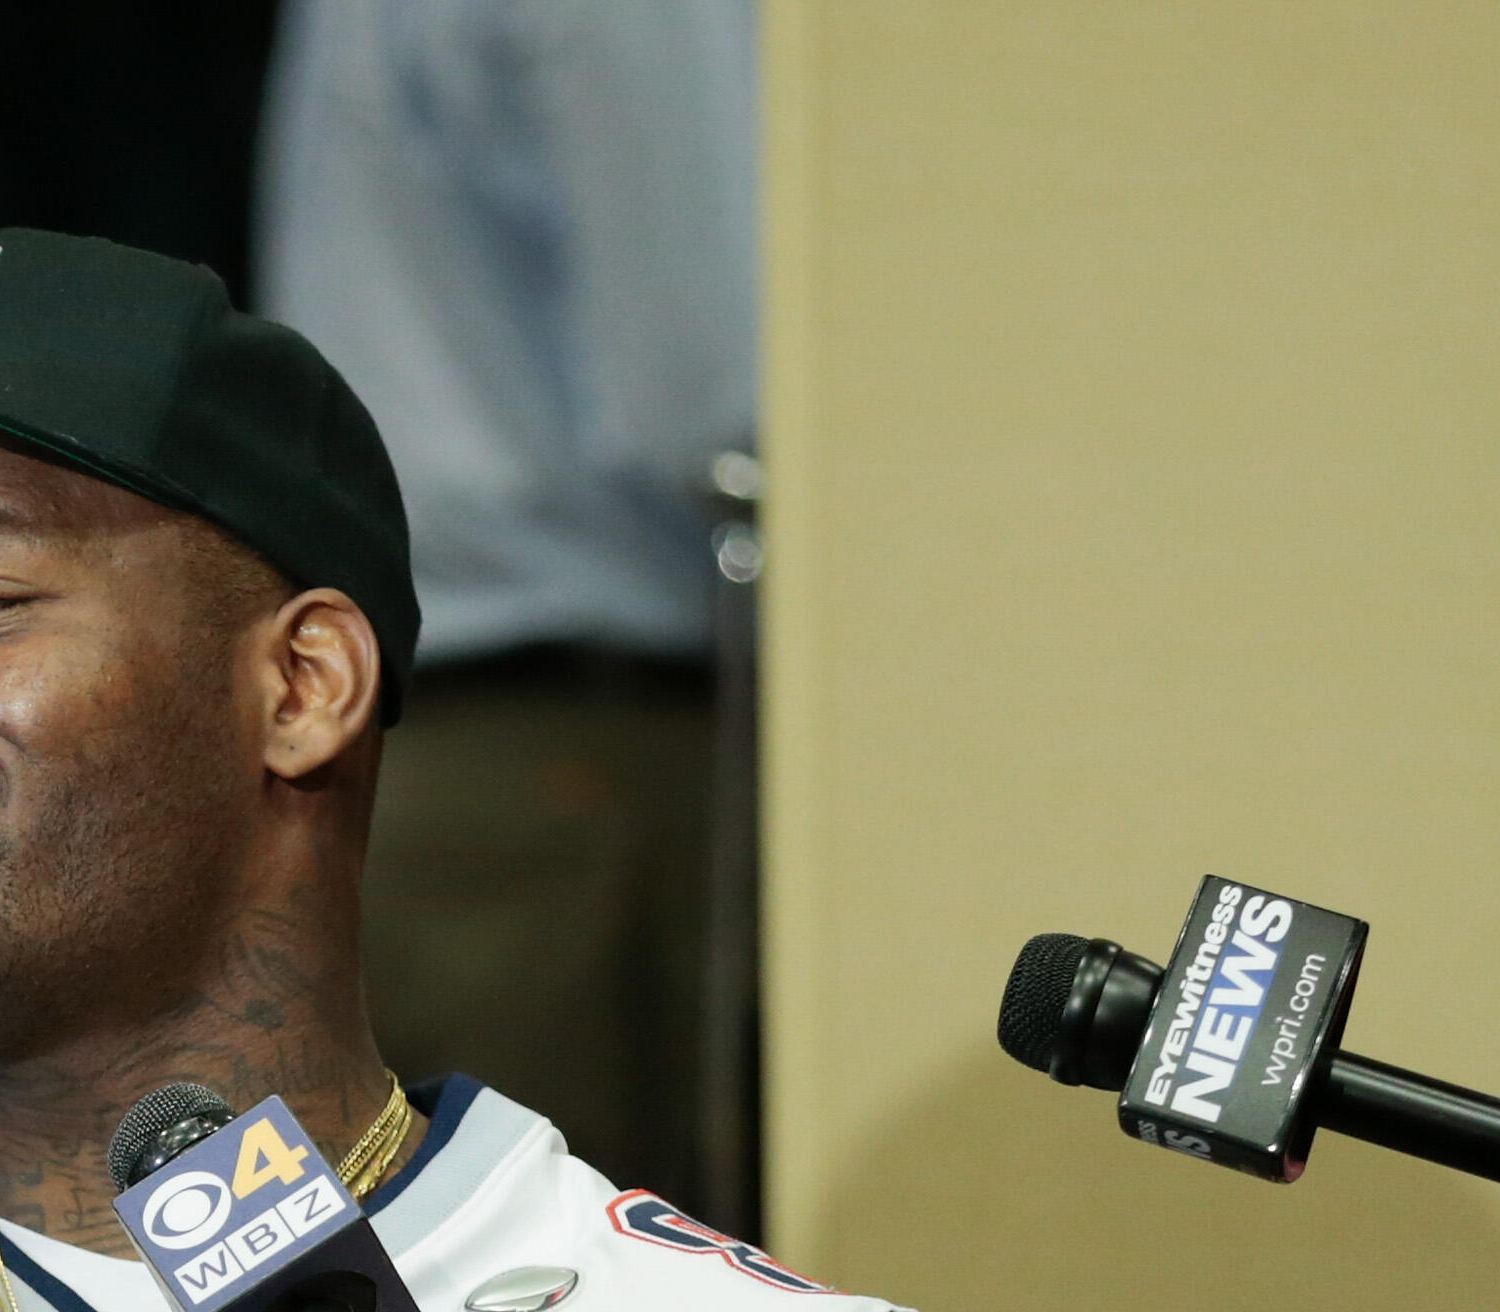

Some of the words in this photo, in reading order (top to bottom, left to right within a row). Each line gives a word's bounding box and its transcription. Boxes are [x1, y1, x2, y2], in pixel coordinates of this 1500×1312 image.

[1170, 895, 1294, 1123] NEWS
[1261, 952, 1327, 1086] wpri.com
[231, 1117, 309, 1200] 4
[180, 1183, 334, 1293] WBZ
